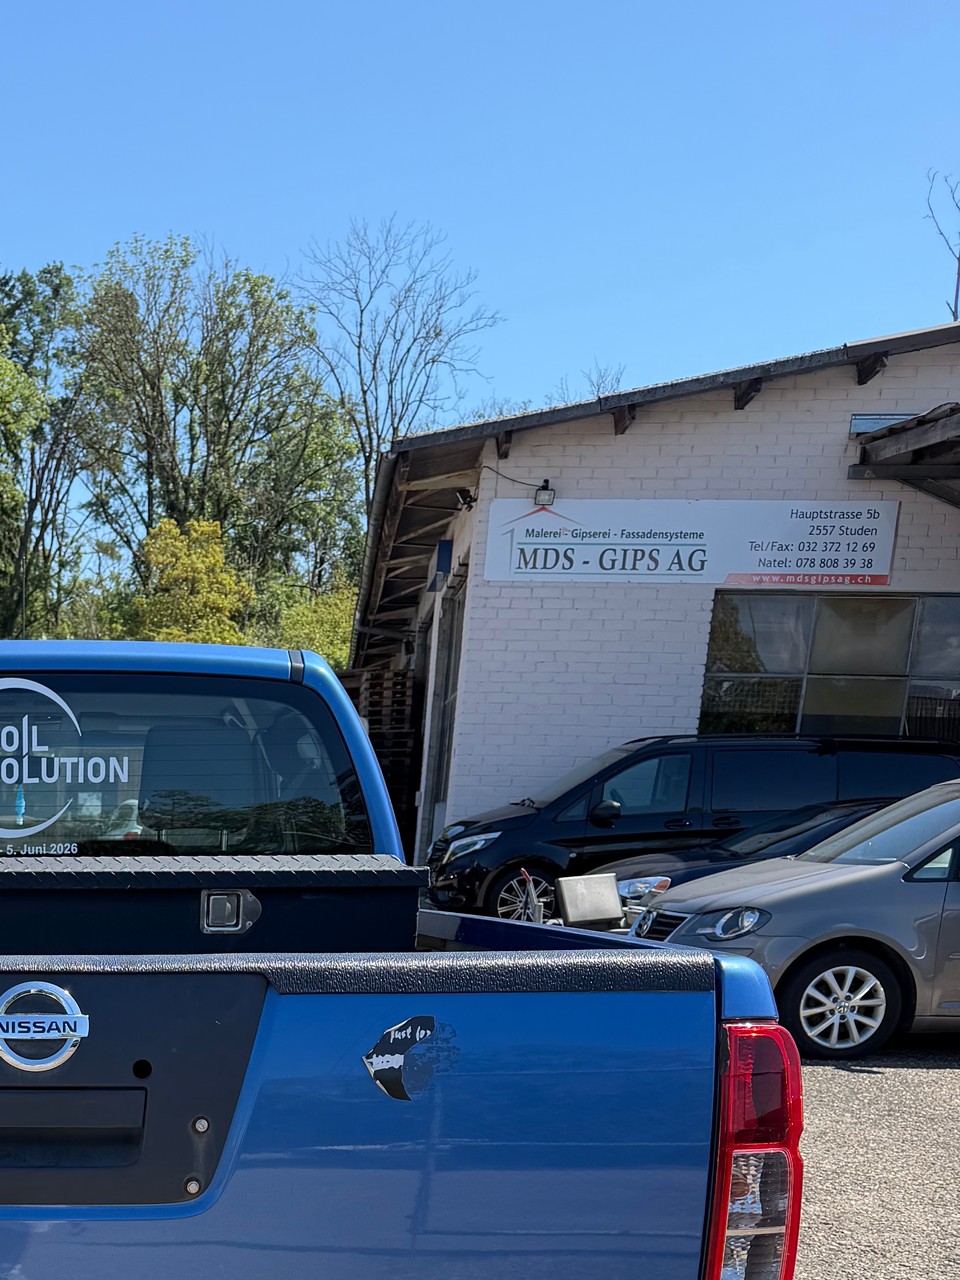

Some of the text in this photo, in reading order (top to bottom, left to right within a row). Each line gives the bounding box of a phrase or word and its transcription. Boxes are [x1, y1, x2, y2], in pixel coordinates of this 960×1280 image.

[790, 509, 880, 521] Hauptstrasse 5b
[525, 528, 562, 539] Malerei
[571, 529, 611, 541] Gipserei
[620, 529, 705, 541] Fassadensysteme
[808, 525, 878, 536] 2557 Studen
[748, 541, 876, 552] Tel/Fax: 032 372 12 69
[515, 547, 575, 571] MDS
[598, 548, 660, 571] GIPS
[666, 548, 708, 572] AG
[758, 557, 873, 569] Natel: 078 808 39 38
[752, 574, 872, 584] www.mdsgipsag.ch
[6, 844, 17, 855] 5.
[20, 843, 46, 854] Juni
[49, 843, 78, 854] 2026
